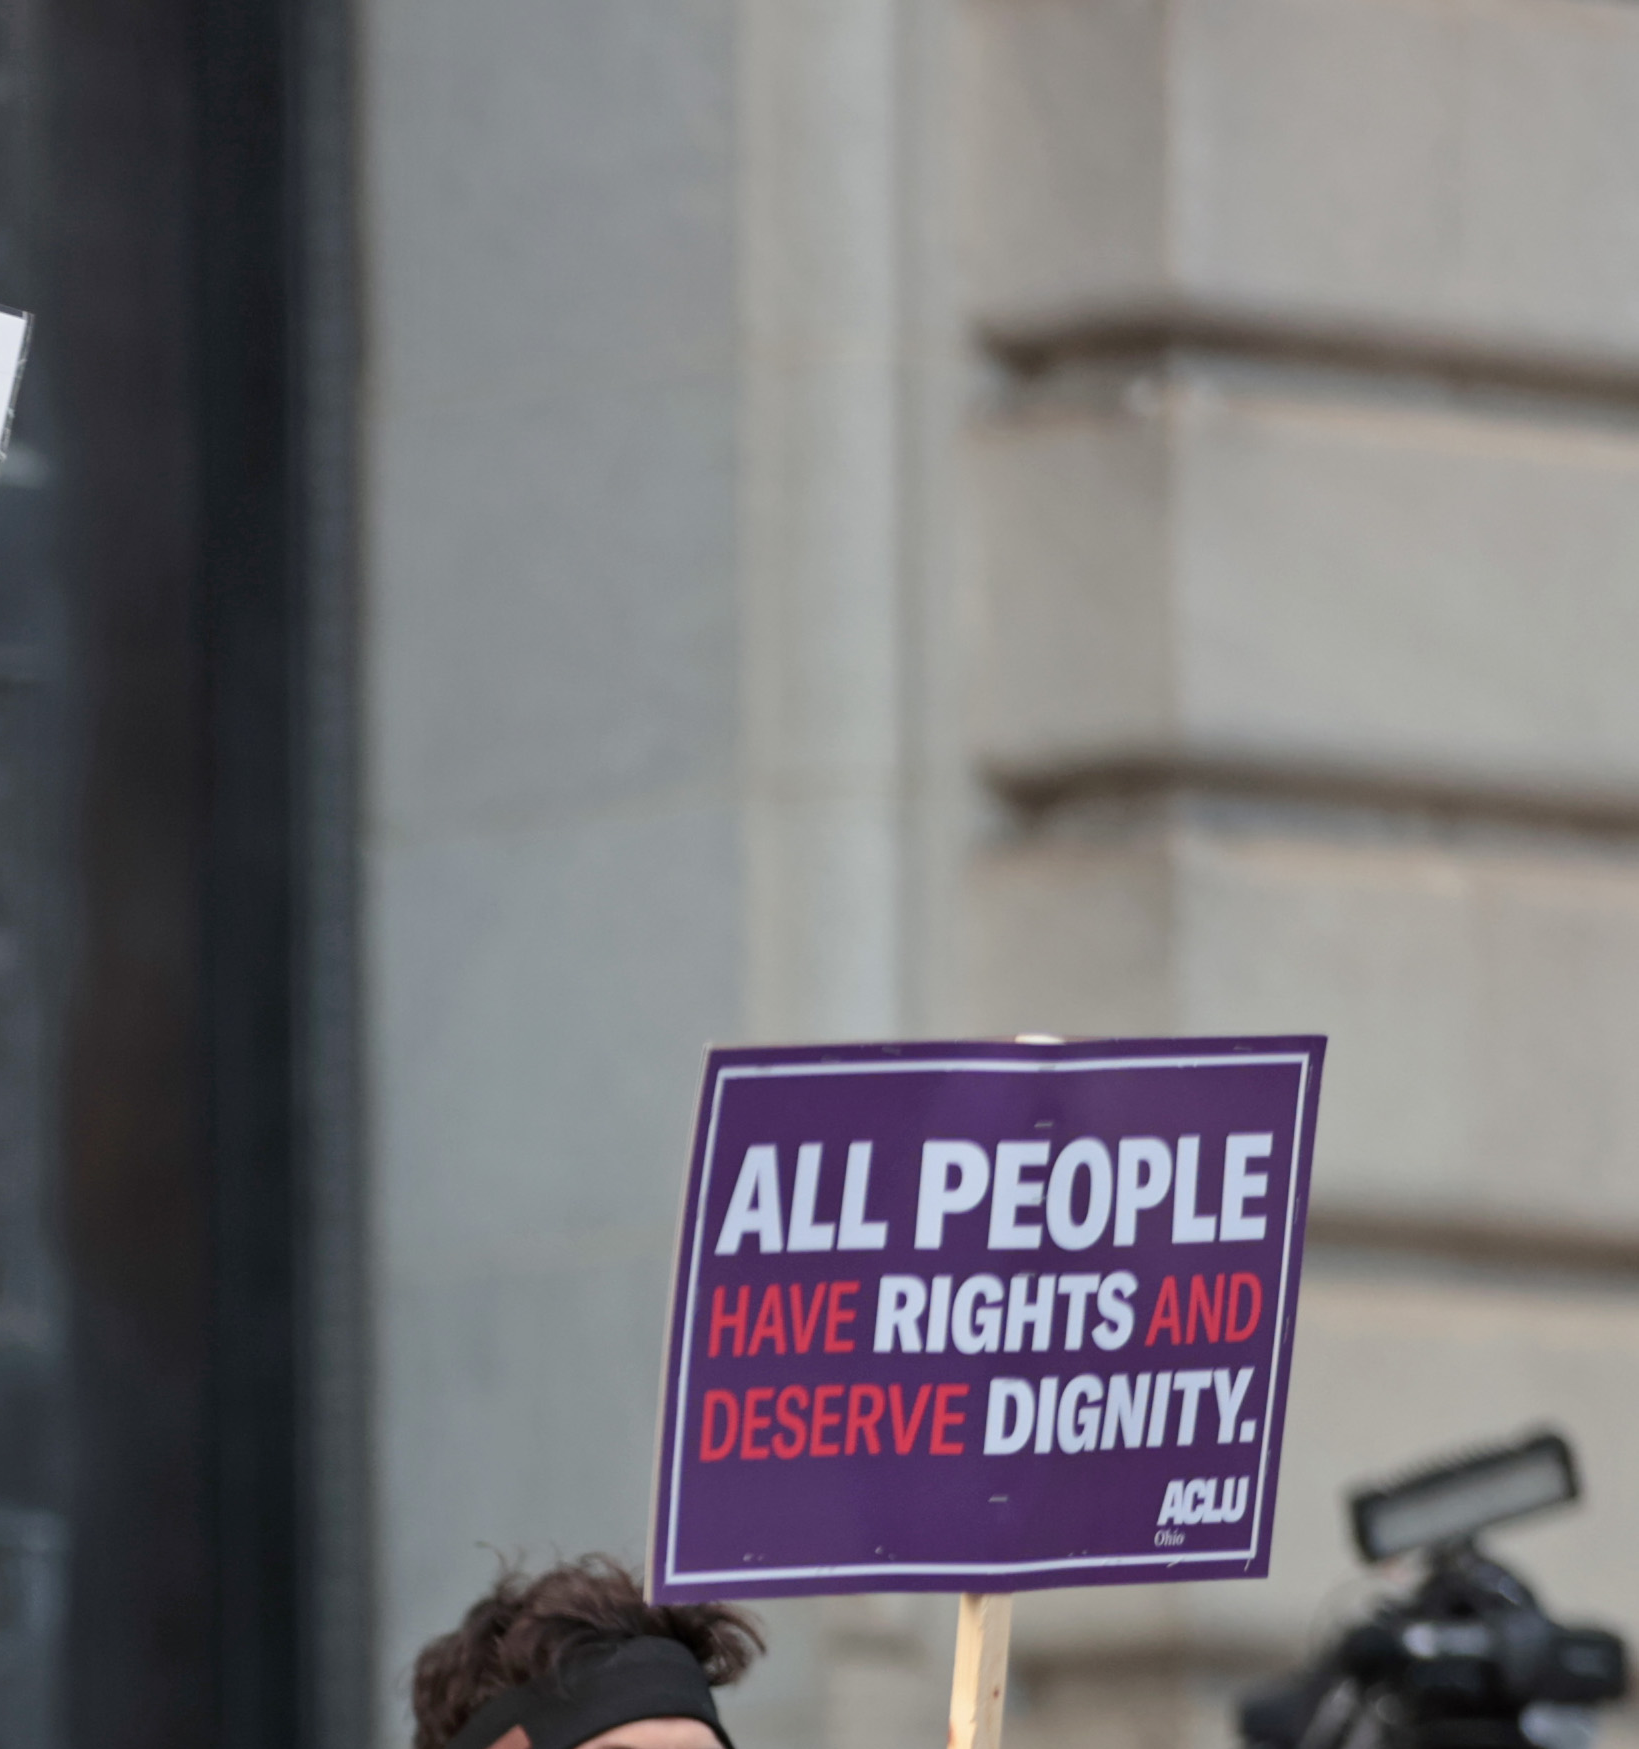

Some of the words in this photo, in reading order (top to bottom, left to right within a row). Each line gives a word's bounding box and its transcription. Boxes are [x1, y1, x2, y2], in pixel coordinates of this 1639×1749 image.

[714, 1142, 888, 1256] ALL
[914, 1132, 1274, 1251] PEOPLE
[707, 1280, 861, 1358] HAVE
[873, 1271, 1138, 1355] RIGHTS
[1144, 1271, 1263, 1347] AND
[699, 1383, 970, 1462] DESERVE
[983, 1368, 1256, 1456] DIGNITY.
[1154, 1528, 1185, 1548] Ohio
[1157, 1476, 1249, 1526] ACLU
